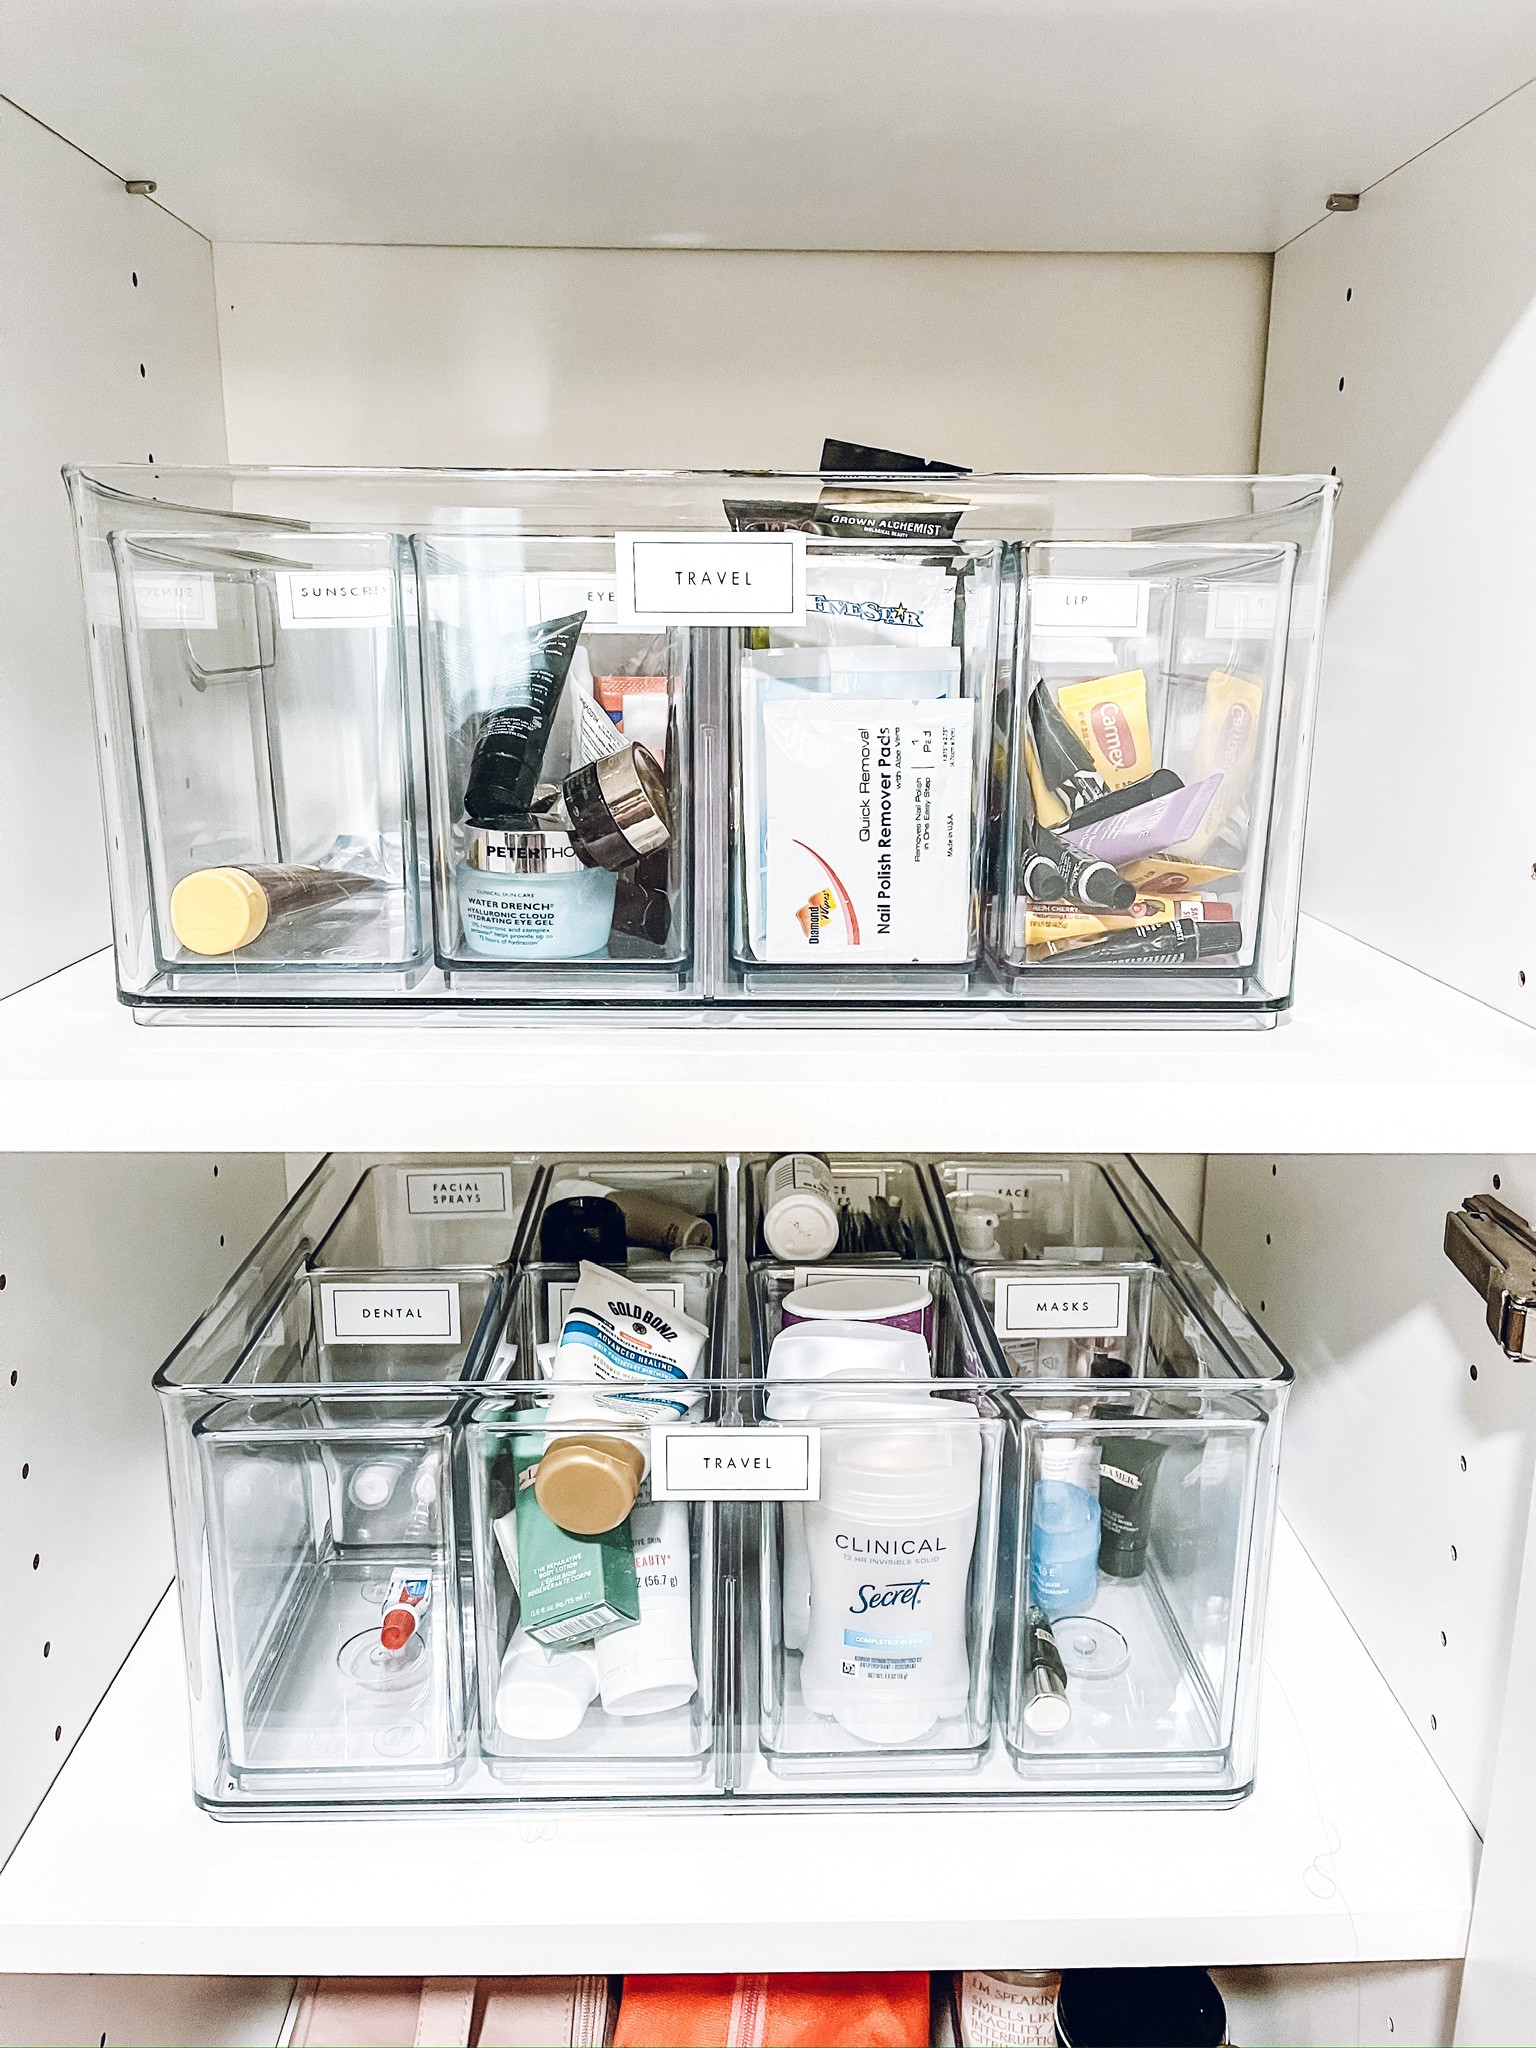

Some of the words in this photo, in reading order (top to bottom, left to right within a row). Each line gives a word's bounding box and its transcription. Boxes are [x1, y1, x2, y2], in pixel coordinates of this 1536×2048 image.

[831, 515, 876, 527] GROWN
[879, 519, 941, 536] ALCHEMIST
[674, 571, 752, 586] TRAVEL
[587, 591, 615, 602] EYE
[1066, 595, 1088, 605] LIP
[1099, 702, 1125, 769] Carmex
[877, 727, 892, 767] Pads
[858, 728, 871, 794] Removal
[915, 777, 923, 803] Polish
[878, 772, 892, 848] Remover
[924, 800, 932, 820] Easy
[859, 799, 871, 842] Quick
[914, 824, 922, 862] Removes
[946, 839, 954, 857] Made
[877, 853, 892, 899] Polish
[468, 897, 499, 909] WATER
[467, 907, 517, 919] HYALURONIC
[468, 913, 512, 925] HYDRATING
[877, 904, 891, 934] Nail
[433, 1183, 479, 1192] FACIAL
[433, 1194, 481, 1204] SPRAYS
[362, 1308, 423, 1319] DENTAL
[1036, 1302, 1090, 1312] MASKS
[607, 1301, 642, 1319] GOLD
[641, 1310, 678, 1342] BOND
[597, 1331, 635, 1360] ADVANCED
[638, 1355, 673, 1372] HEALING
[703, 1457, 772, 1469] TRAVEL
[835, 1534, 947, 1555] CLINICAL
[533, 1565, 546, 1575] THE
[546, 1552, 583, 1570] REPARATIVE
[538, 1569, 554, 1579] BODY
[555, 1560, 578, 1573] LOTION
[635, 1554, 666, 1568] EAUTY
[869, 1558, 912, 1566] INVISIBLE
[915, 1556, 940, 1564] SOLID
[571, 1570, 592, 1582] CORPS
[645, 1574, 667, 1587] (56.7
[849, 1578, 931, 1614] Secret
[855, 1636, 899, 1646] COMPLETELY
[994, 1989, 1054, 2006] SPEAKIN
[971, 2006, 1043, 2035] FRAGILITY
